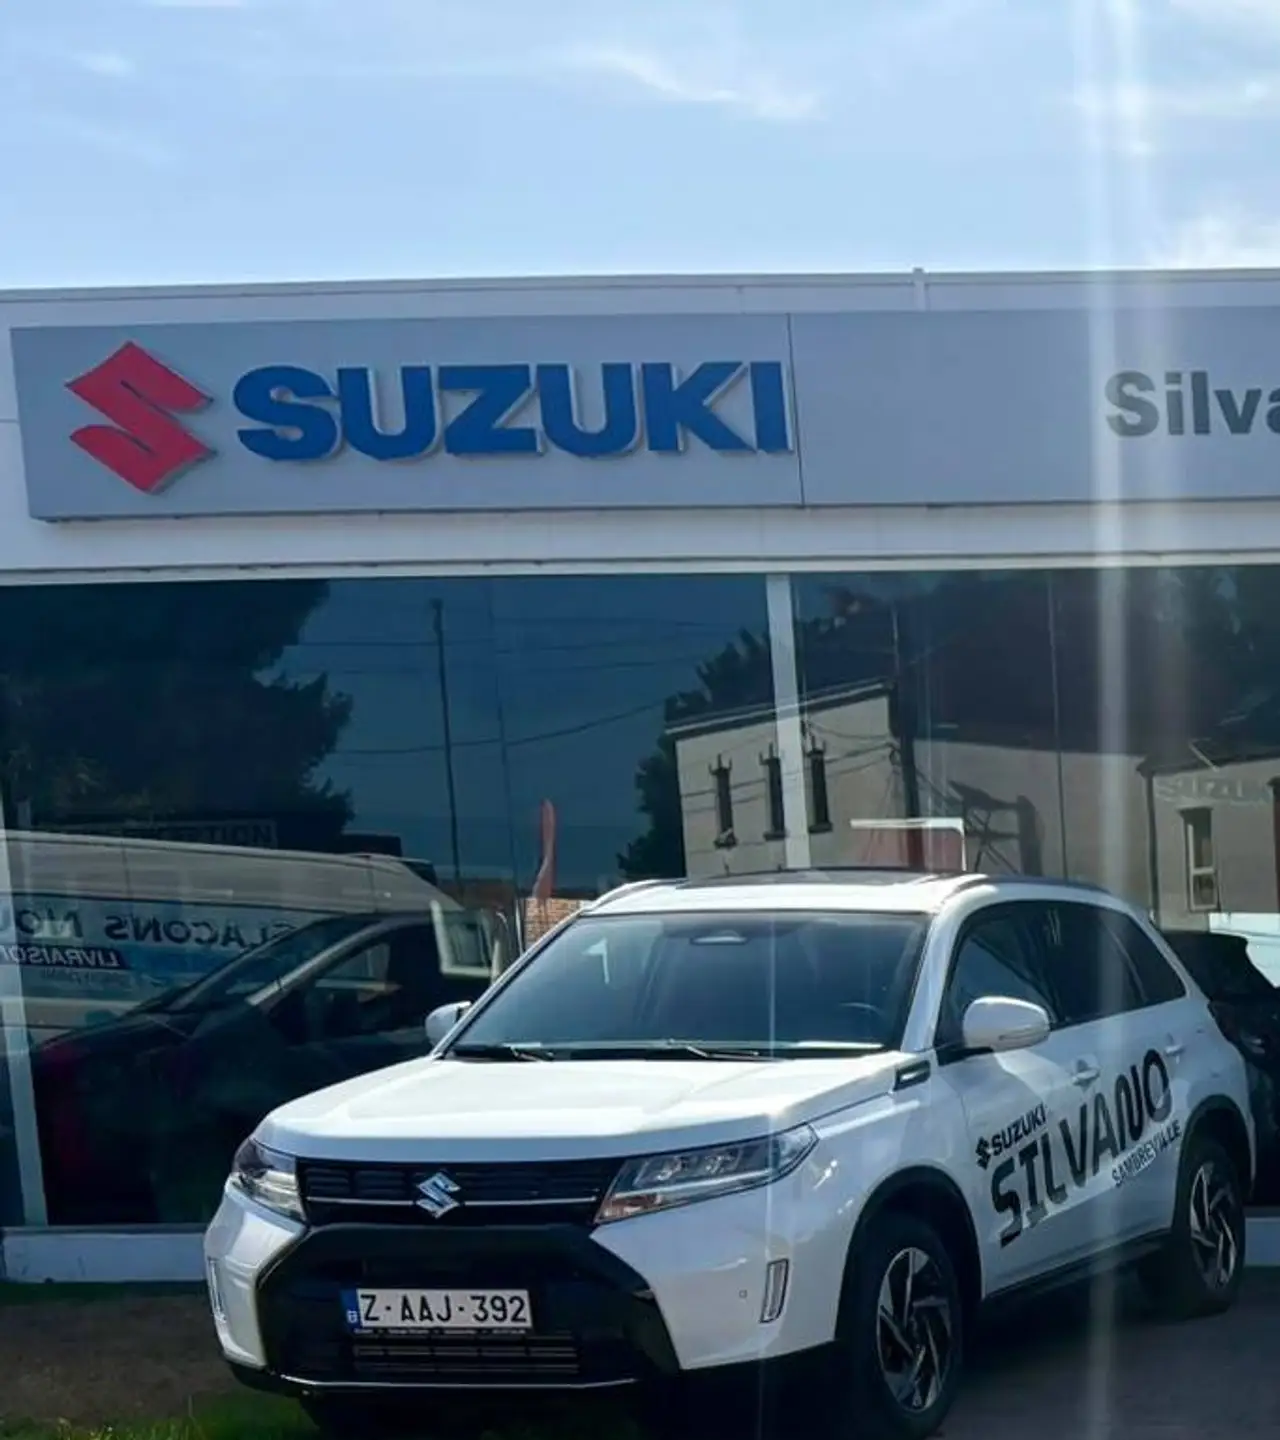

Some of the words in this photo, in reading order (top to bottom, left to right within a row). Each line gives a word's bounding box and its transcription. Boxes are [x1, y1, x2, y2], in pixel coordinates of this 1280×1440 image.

[233, 361, 791, 461] SUZUKI
[990, 1048, 1173, 1248] SILVANO
[991, 1101, 1047, 1156] SUZUKI
[1111, 1119, 1183, 1188] SAMBREVILLE
